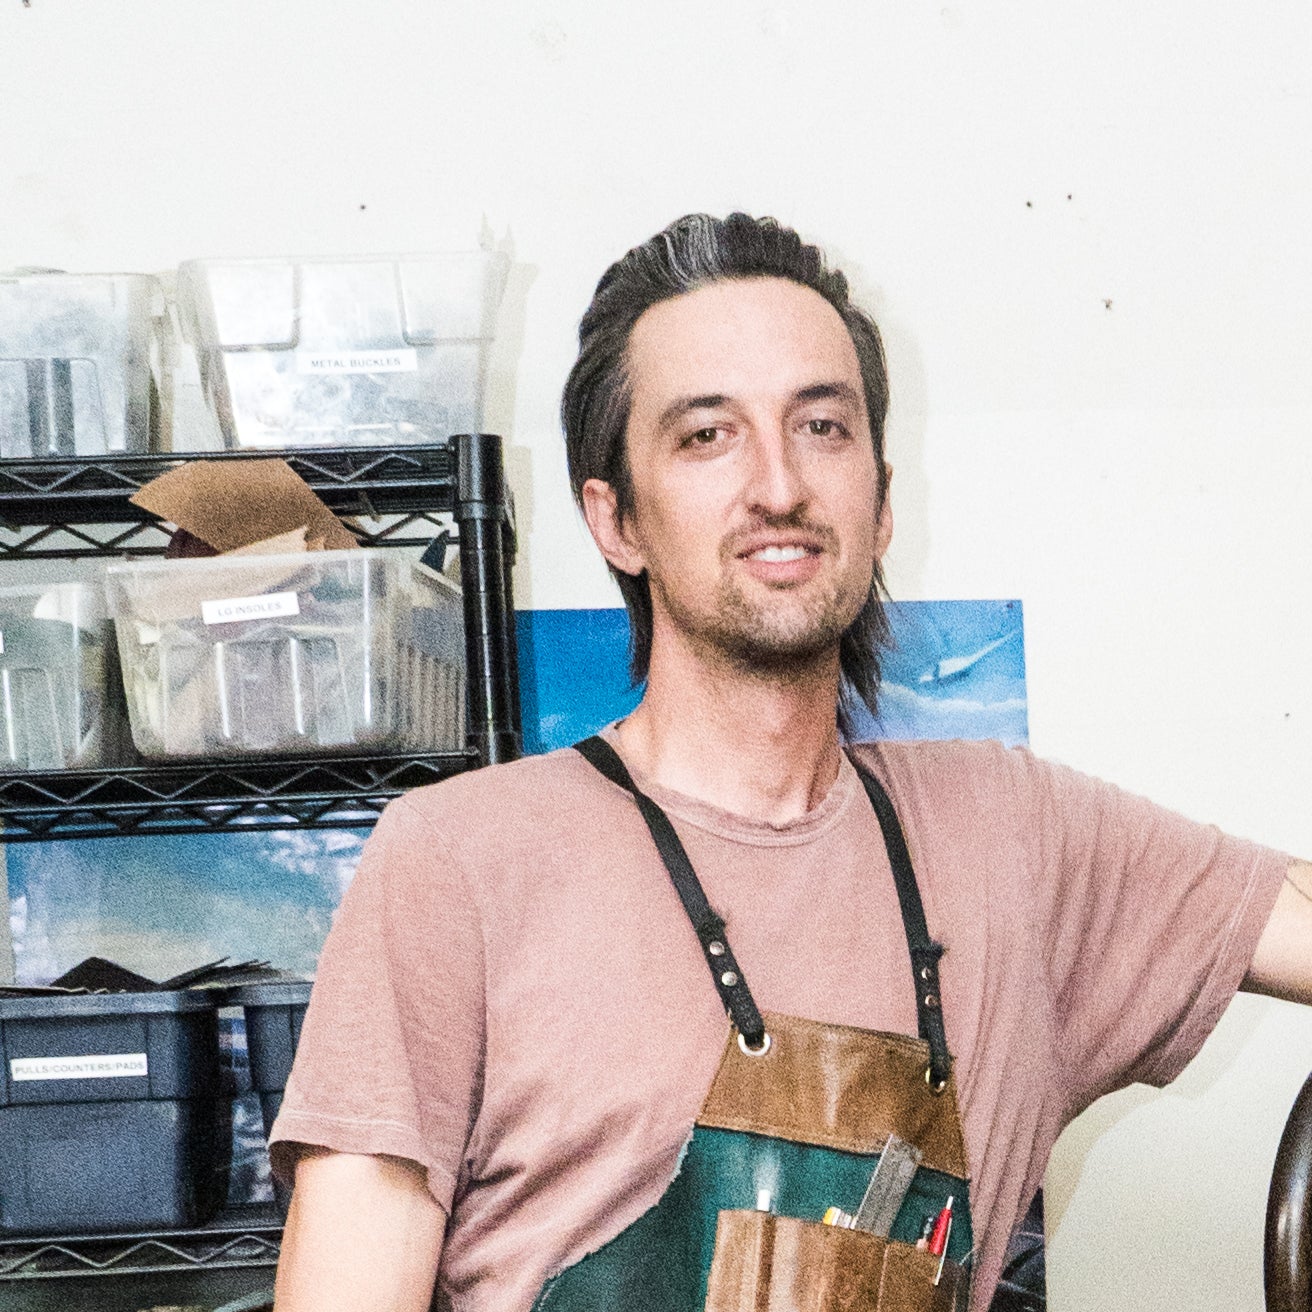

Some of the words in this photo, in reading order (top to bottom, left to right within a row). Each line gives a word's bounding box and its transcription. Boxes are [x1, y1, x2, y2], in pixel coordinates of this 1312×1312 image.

[311, 359, 345, 369] METAL
[350, 357, 401, 368] BUCKLES
[235, 601, 283, 615] INSOLES
